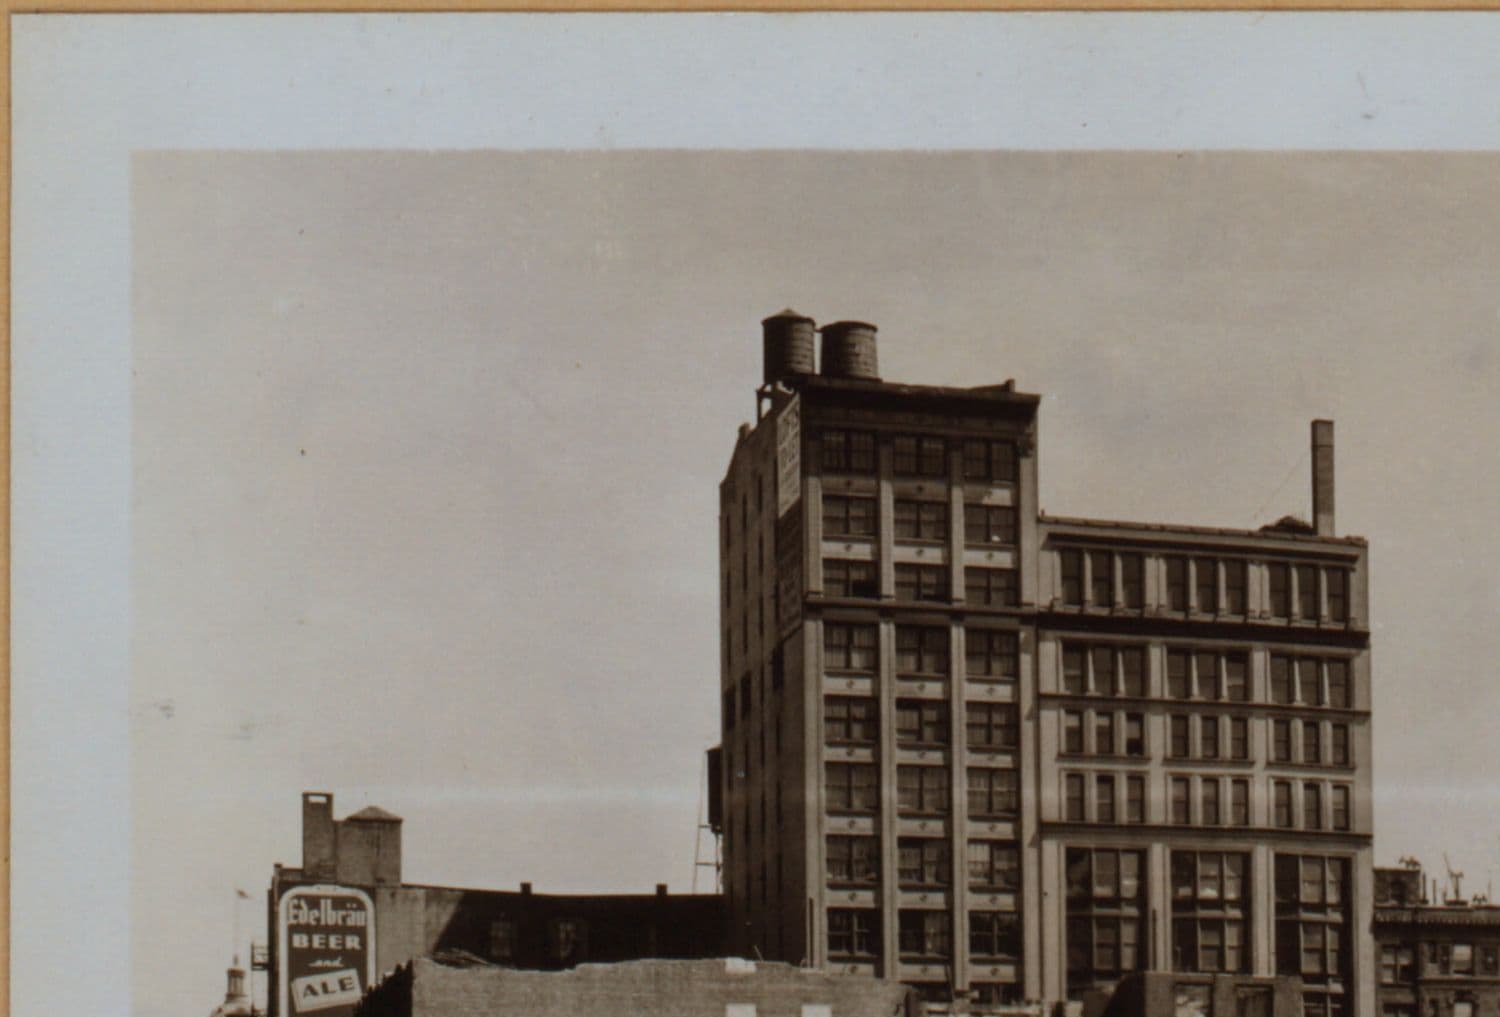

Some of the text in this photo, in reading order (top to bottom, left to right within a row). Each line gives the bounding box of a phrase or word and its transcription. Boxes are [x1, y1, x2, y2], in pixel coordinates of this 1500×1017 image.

[292, 933, 361, 950] BEER
[308, 956, 344, 967] and
[303, 976, 355, 999] ALE
